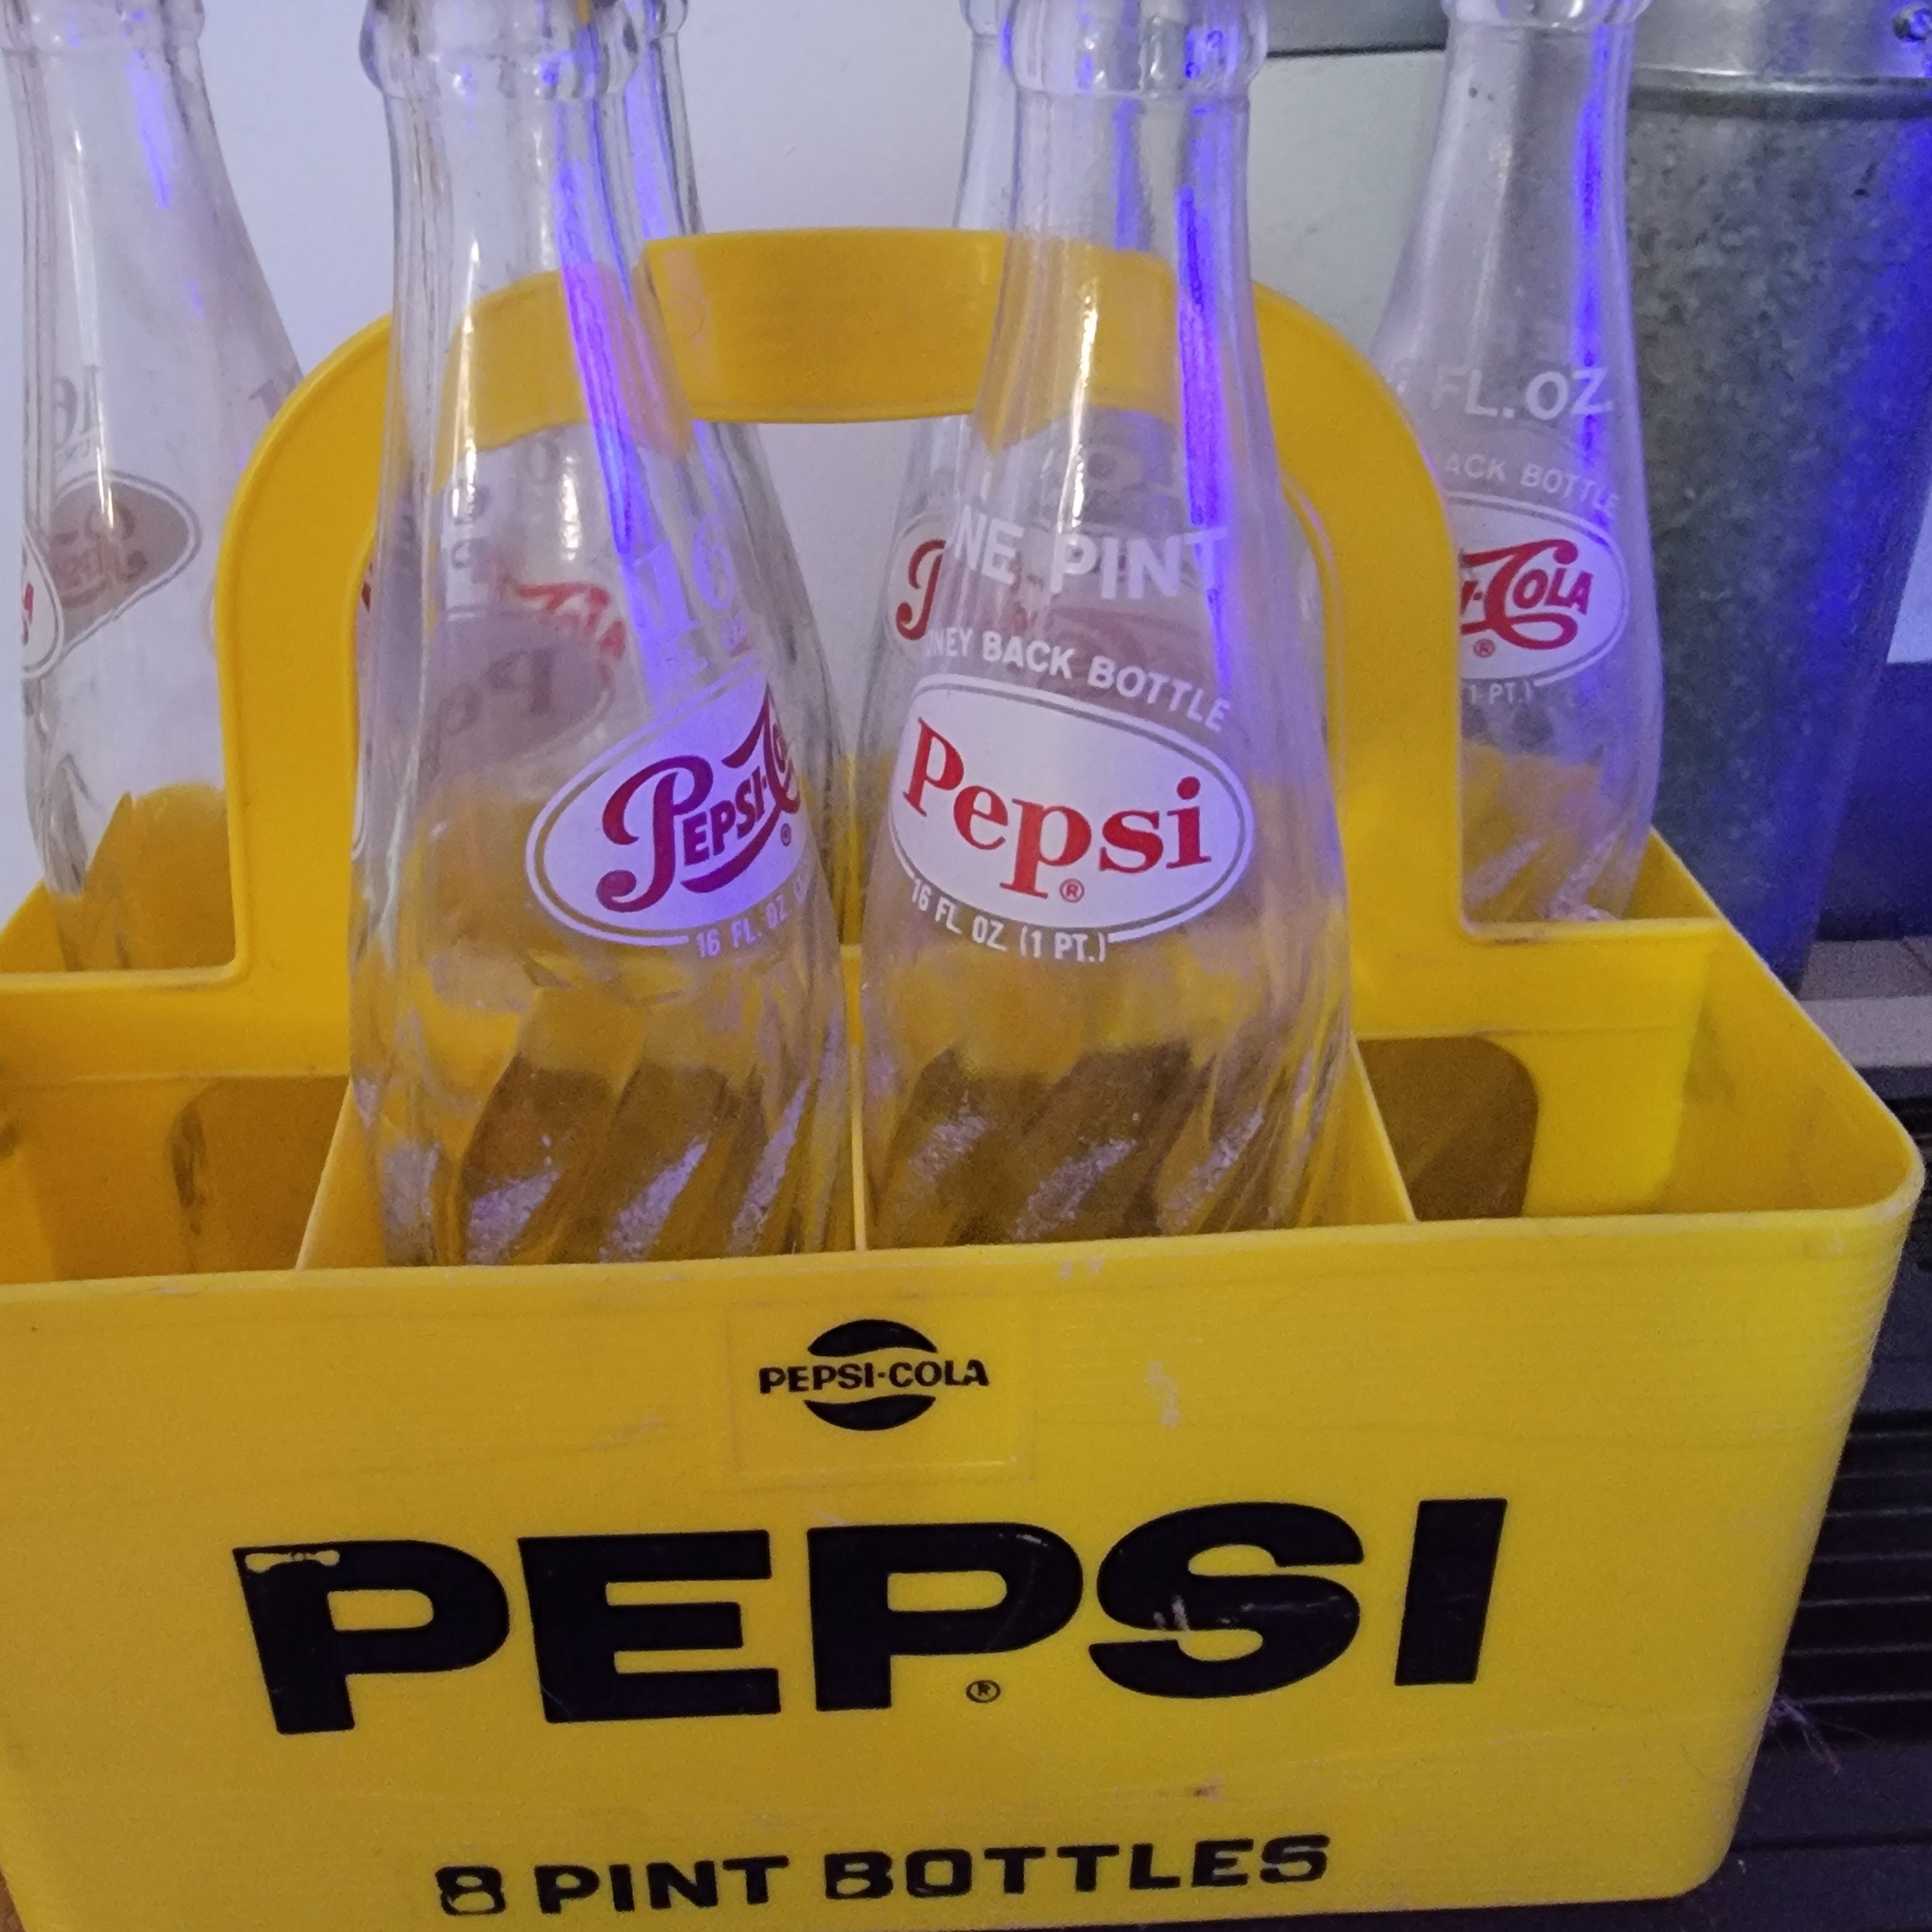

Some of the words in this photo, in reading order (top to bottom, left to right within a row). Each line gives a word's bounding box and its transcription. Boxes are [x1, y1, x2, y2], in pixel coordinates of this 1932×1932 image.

[1444, 452, 1506, 482] ACK
[1520, 462, 1619, 515] BOTTLE
[954, 506, 1023, 585] NE
[1050, 526, 1227, 601] PINT
[1461, 539, 1594, 650] I-COLA
[923, 626, 974, 657] NEY
[982, 630, 1076, 679] BACK
[1087, 655, 1233, 733] BOTTLE
[903, 716, 1212, 899] Pepsi
[697, 929, 721, 958] 16
[911, 879, 932, 912] 16
[935, 896, 962, 935] FL
[971, 915, 1008, 952] OZ
[1019, 925, 1042, 959] (1
[1054, 931, 1106, 963] PT.)
[233, 1498, 1508, 1734] PEPSI
[435, 1865, 507, 1916] 8
[533, 1855, 790, 1914] PINT
[824, 1834, 1331, 1900] BOTTLES
